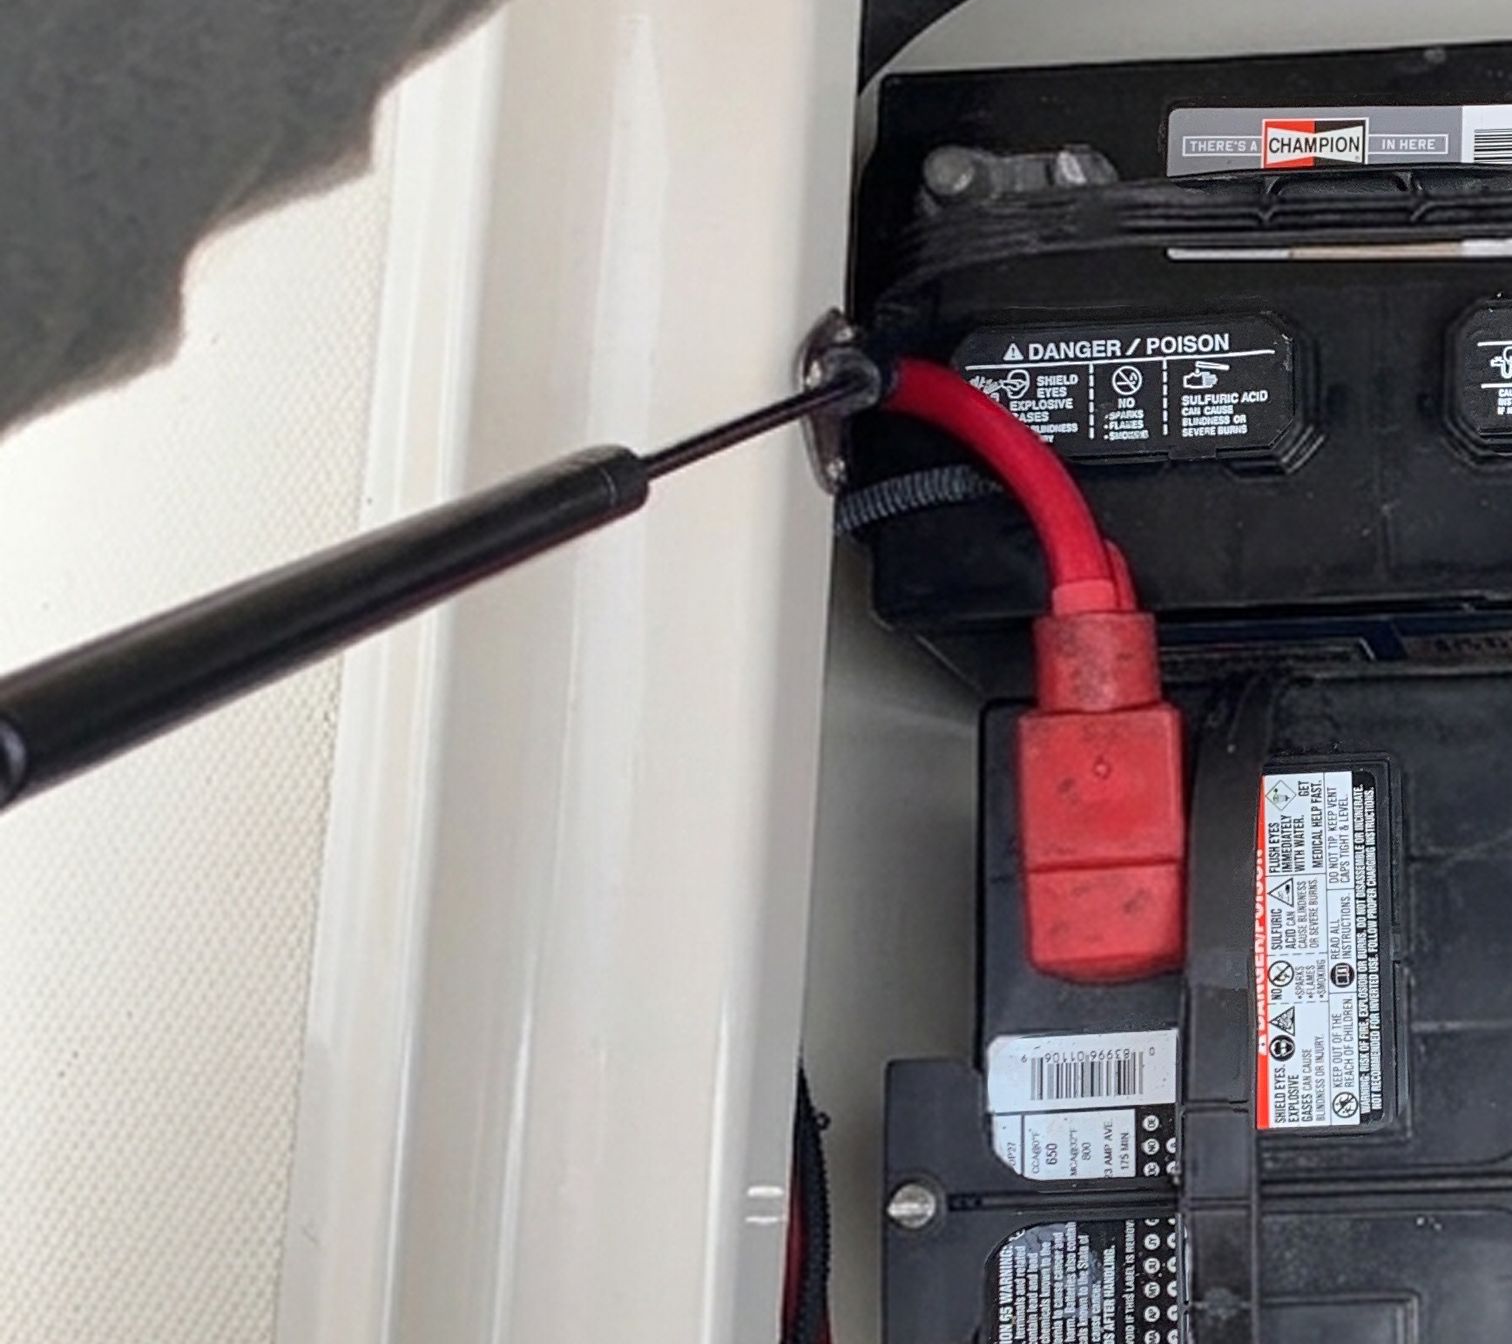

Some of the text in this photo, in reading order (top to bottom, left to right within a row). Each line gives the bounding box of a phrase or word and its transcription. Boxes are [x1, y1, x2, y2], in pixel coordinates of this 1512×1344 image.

[1190, 135, 1435, 153] THERE'S A CHAMPION IN HERE
[1029, 334, 1229, 361] DANGER POISON
[1037, 375, 1078, 385] SHIELD
[1038, 387, 1067, 397] EYES
[1181, 391, 1268, 405] SULFURIC ACID
[1010, 399, 1073, 411] EXPLOSIVE
[1118, 399, 1135, 409] NO
[1182, 405, 1233, 415] CAN CAUSE
[1498, 406, 1505, 415] IF
[1182, 415, 1246, 426] BLINDNESS OR
[1182, 426, 1247, 437] SEVERE BURNS
[1298, 781, 1309, 796] GET
[1311, 780, 1323, 868] MEDICAL HELP FAST.
[1327, 787, 1338, 883] DO NOT KEEP VENT
[1268, 823, 1280, 872] FLUSH EYES
[1281, 815, 1292, 872] IMMEDIATELY
[1293, 815, 1305, 871] WITH WATER.
[1340, 835, 1349, 857] TIGHT
[1354, 833, 1363, 842] OR
[1340, 861, 1350, 883] CAPS
[1355, 845, 1365, 896] DISASSEMBLE
[1366, 847, 1375, 886] CHARGING
[1297, 881, 1307, 948] CAUSE BLINDNESS
[1355, 898, 1365, 914] NOT
[1367, 888, 1376, 918] PROPER
[1271, 909, 1282, 950] SULFURIC
[1286, 912, 1296, 948] ACID CAN
[1309, 908, 1318, 948] OR SEVERE
[1356, 917, 1365, 927] DO
[1330, 920, 1340, 959] READ ALL
[1368, 921, 1377, 952] FOLLOW
[1358, 961, 1366, 971] OR
[1271, 989, 1282, 1000] NO
[1358, 974, 1368, 1016] EXPLOSION
[1369, 975, 1379, 1010] INVERTED
[1370, 1014, 1379, 1028] FOR
[1045, 1049, 1130, 1063] 83996 01106
[1332, 1014, 1341, 1088] KEEP OUT OF THE
[1360, 1041, 1368, 1051] OF
[1345, 1045, 1354, 1087] REACH OF
[1361, 1053, 1369, 1071] RISK
[1371, 1031, 1381, 1091] RECOMMENDED
[1274, 1064, 1286, 1123] SHIELD EYES.
[1302, 1049, 1312, 1121] GASES CAN CAUSE
[1315, 1066, 1325, 1121] BLINDNESS OR
[1288, 1075, 1299, 1122] EXPLOSIVE
[1372, 1094, 1381, 1109] NOT
[1046, 1144, 1057, 1165] 650
[1121, 1133, 1129, 1170] 175 MIN
[1104, 1245, 1115, 1296] HANDLING.
[1125, 1255, 1133, 1263] IS
[1125, 1266, 1134, 1291] LABEL
[1000, 1308, 1012, 1321] 65
[1104, 1299, 1114, 1330] AFTER
[1125, 1294, 1134, 1312] THIS
[1125, 1315, 1134, 1323] IF
